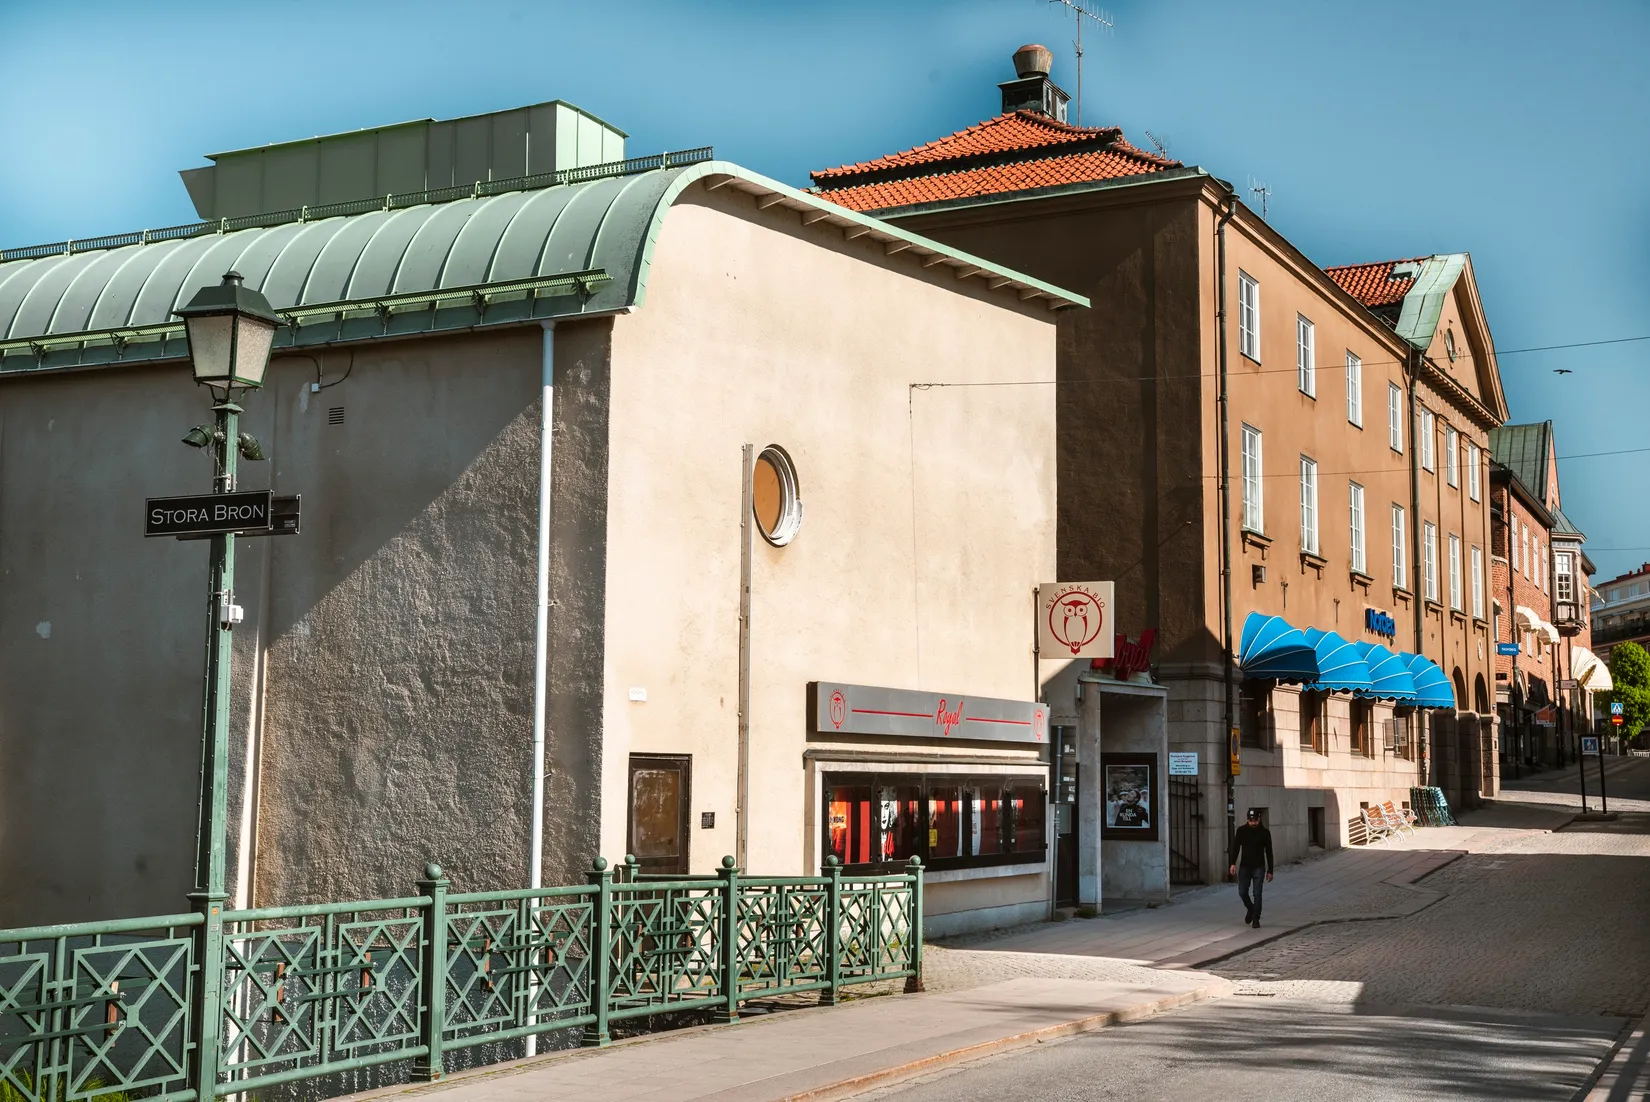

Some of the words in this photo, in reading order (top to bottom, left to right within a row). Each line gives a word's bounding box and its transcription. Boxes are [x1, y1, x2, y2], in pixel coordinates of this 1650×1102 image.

[1045, 584, 1090, 610] SVENSKA
[1092, 592, 1106, 609] BIO
[1366, 608, 1395, 636] Nordea
[936, 699, 963, 736] Royal
